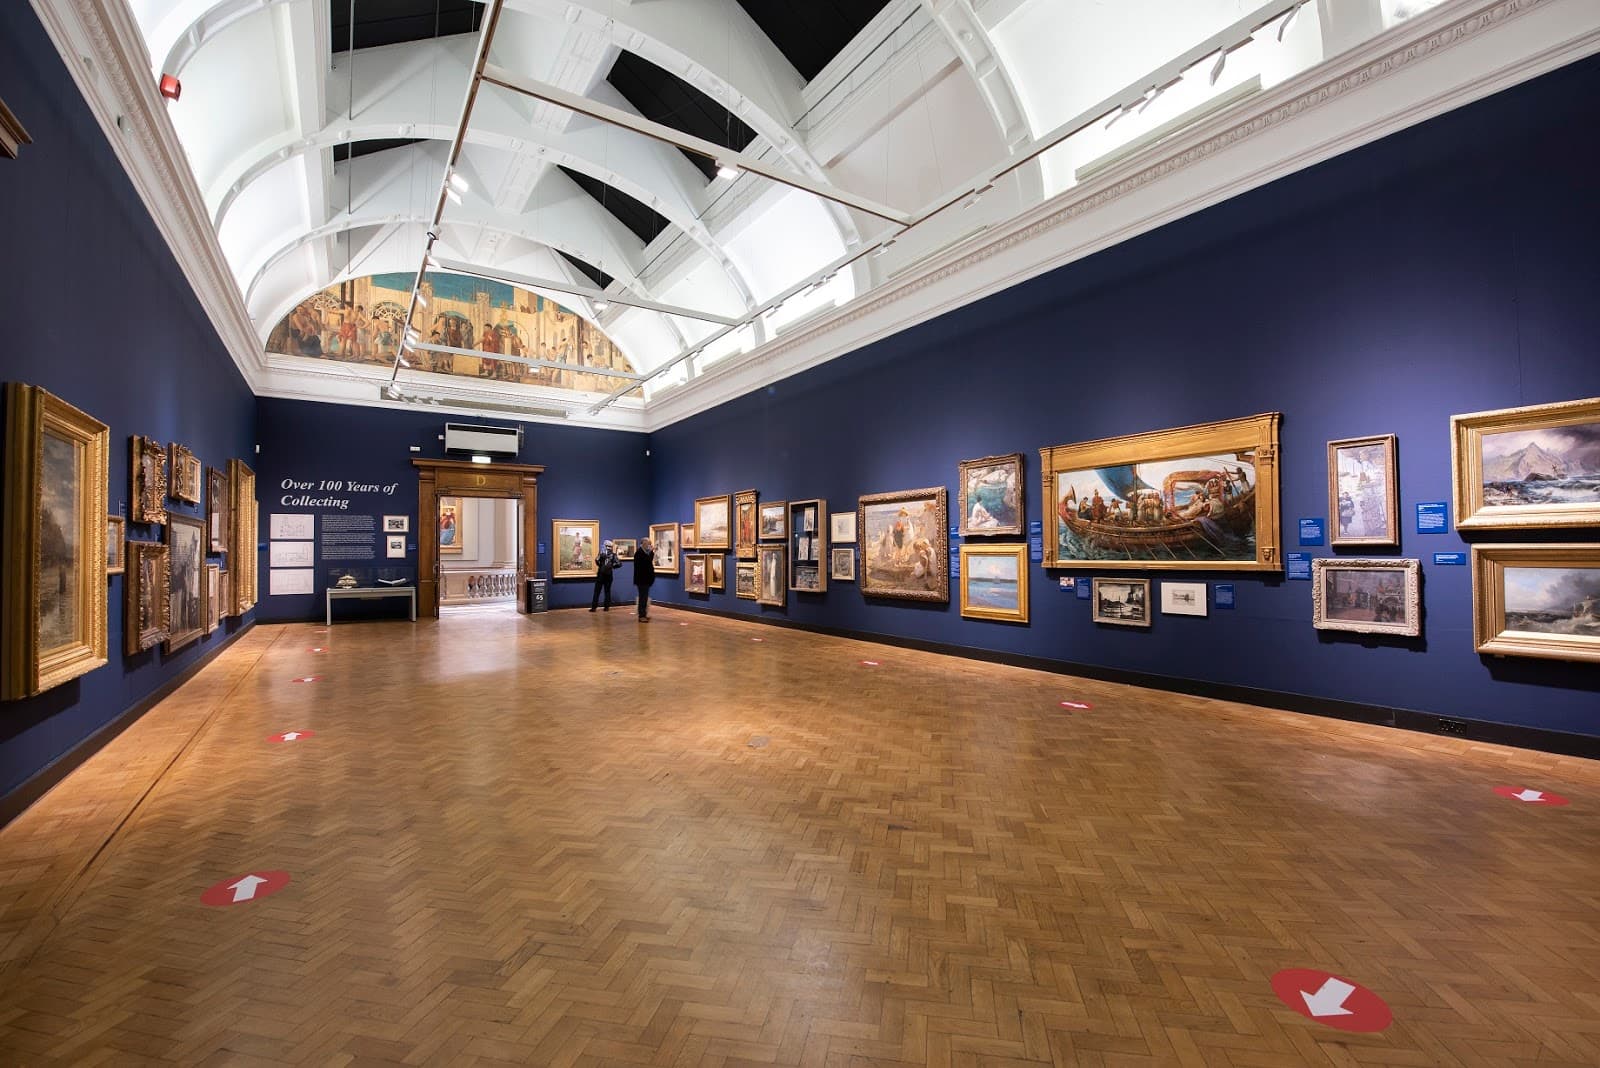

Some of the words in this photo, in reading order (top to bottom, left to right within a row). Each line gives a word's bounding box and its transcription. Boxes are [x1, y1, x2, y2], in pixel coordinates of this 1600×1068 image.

[281, 478, 314, 490] Over
[318, 480, 343, 491] 100
[346, 481, 380, 492] Years
[383, 483, 399, 495] of
[476, 474, 486, 486] D
[281, 494, 349, 510] Collecting
